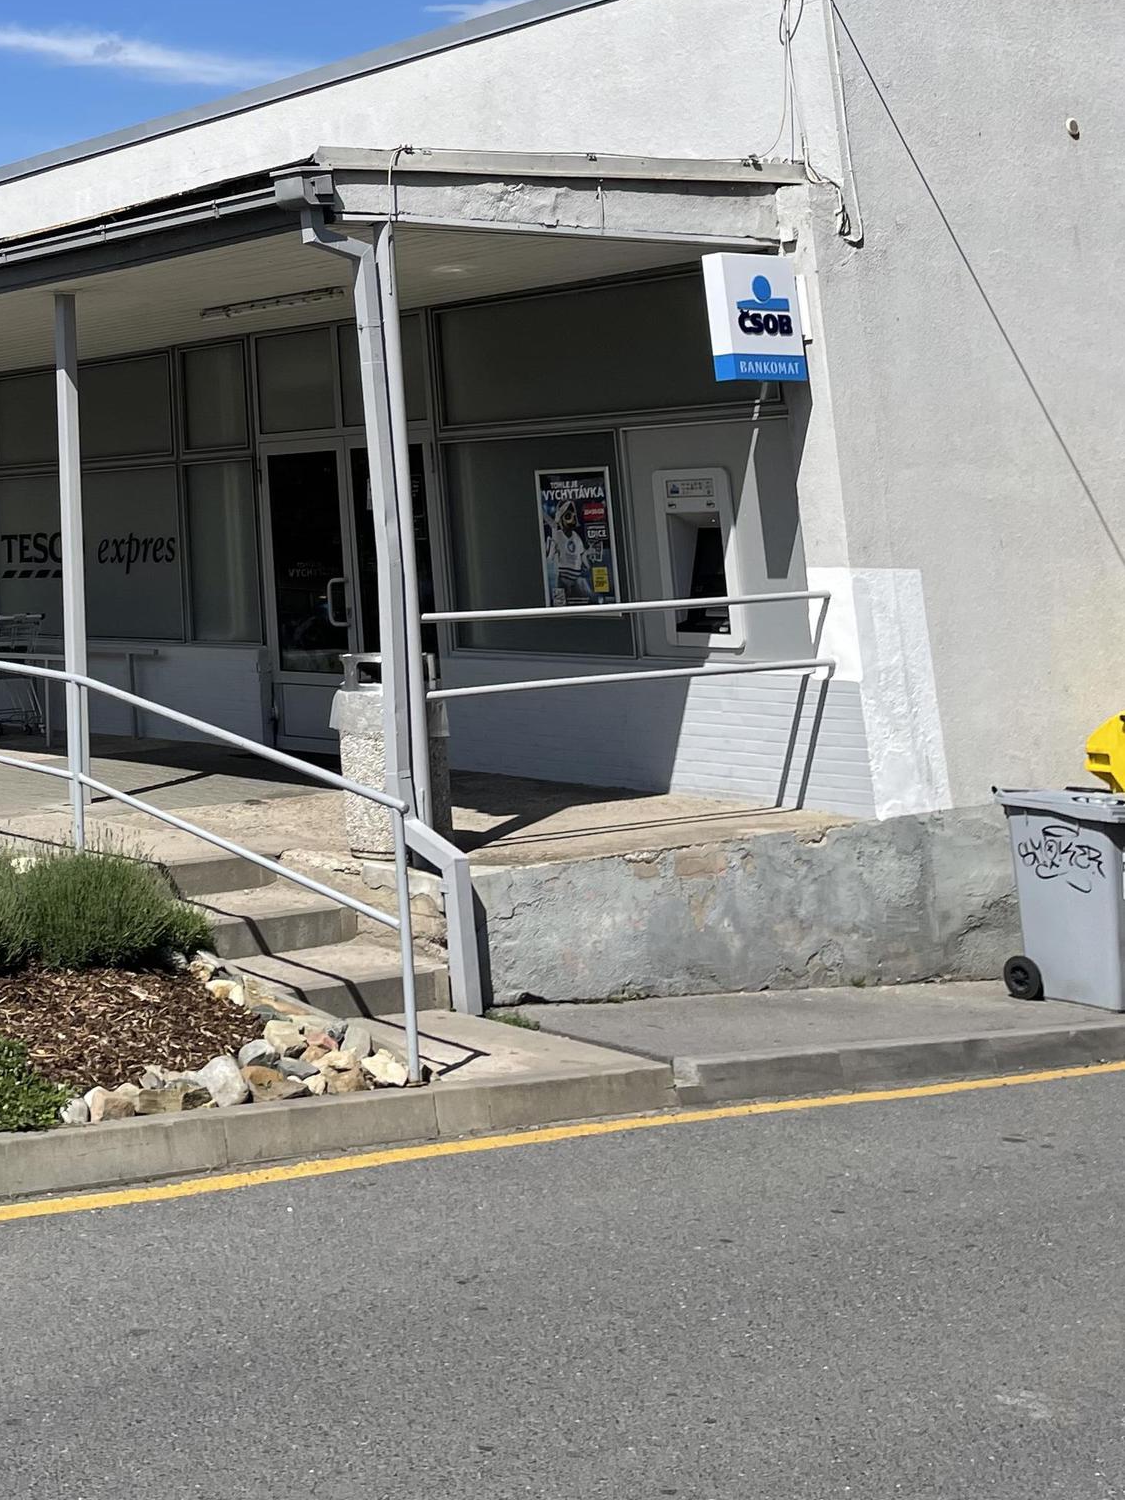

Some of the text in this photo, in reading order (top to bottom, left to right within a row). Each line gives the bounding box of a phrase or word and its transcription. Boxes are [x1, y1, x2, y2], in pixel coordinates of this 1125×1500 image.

[738, 309, 793, 335] ČSOB
[740, 361, 800, 375] BANKOMAT
[542, 485, 605, 501] VYCHYTÁVKA
[1, 532, 176, 575] TESC expres
